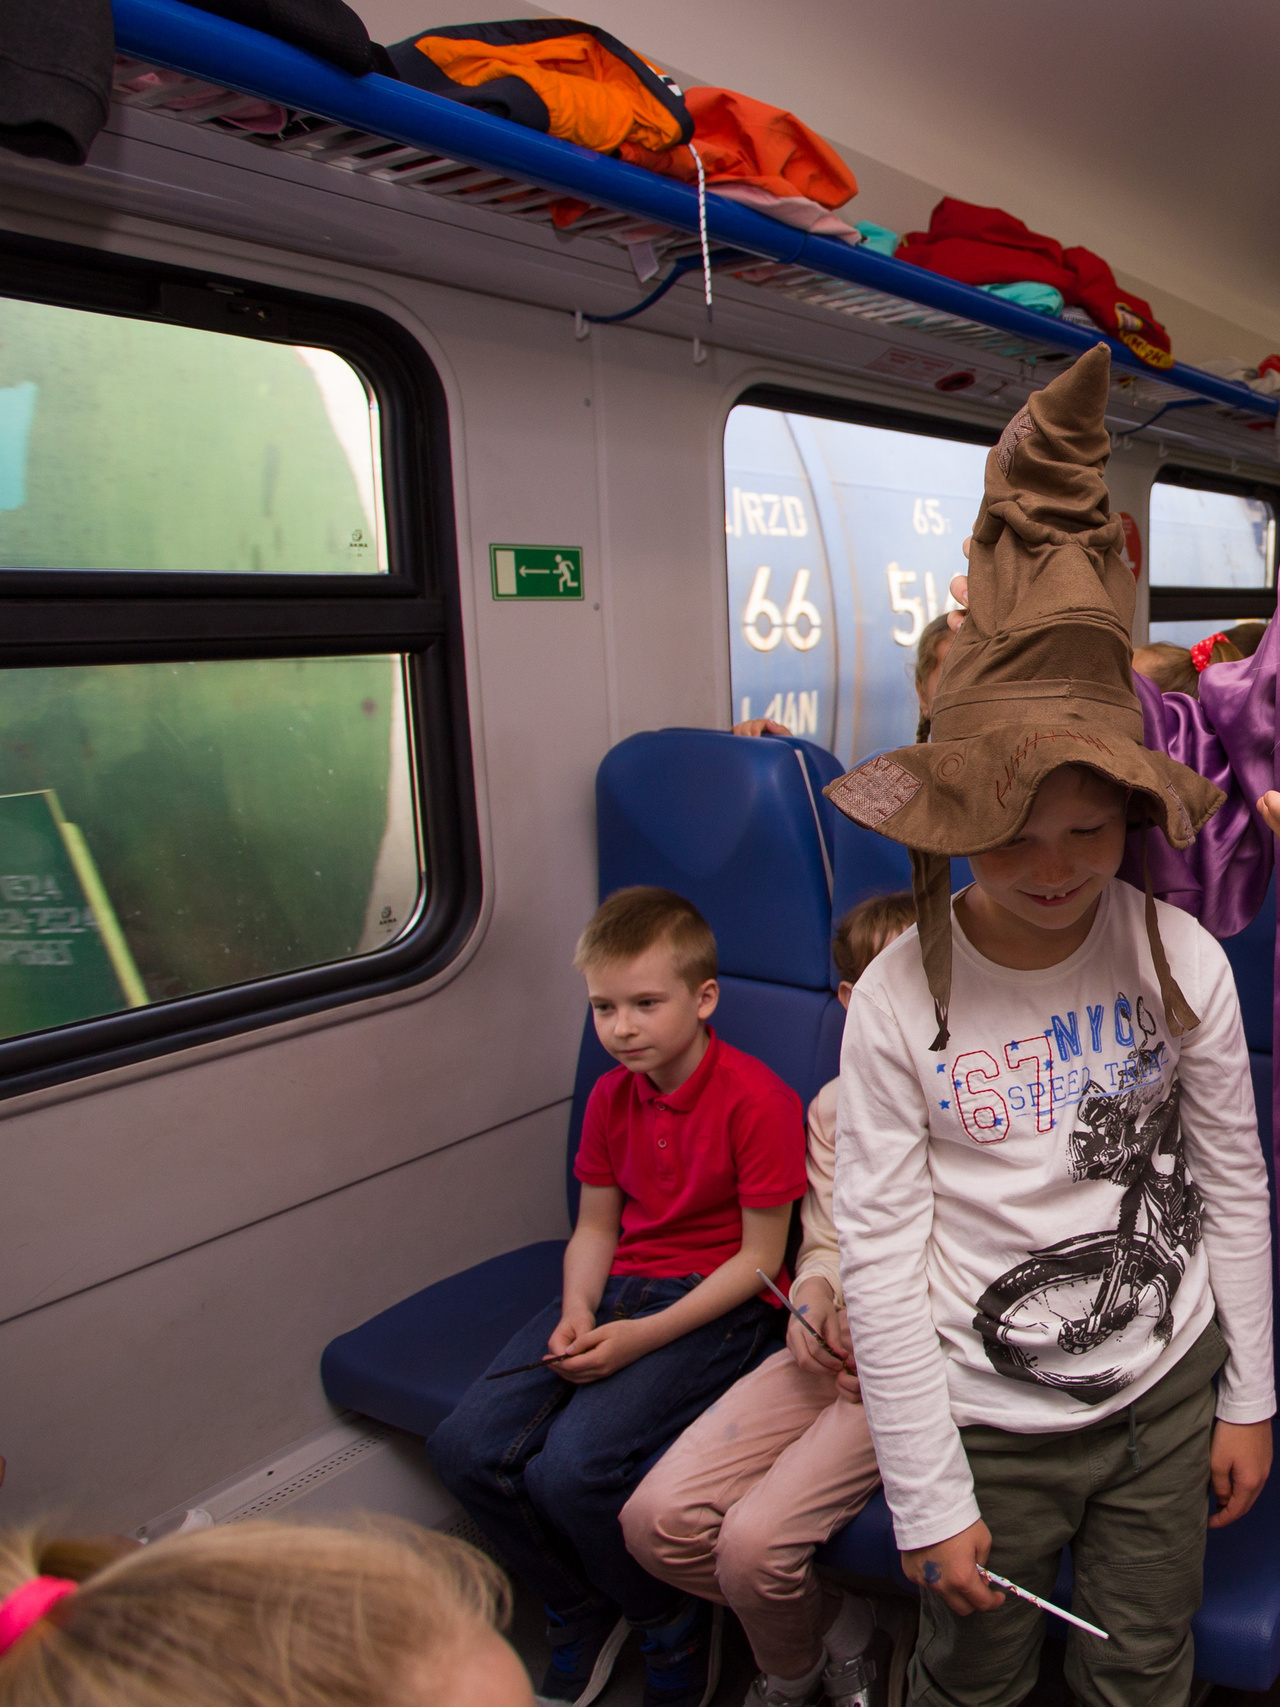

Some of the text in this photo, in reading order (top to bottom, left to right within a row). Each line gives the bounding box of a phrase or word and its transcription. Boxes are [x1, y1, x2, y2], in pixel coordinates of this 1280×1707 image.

[743, 566, 822, 652] 66
[1051, 998, 1137, 1062] NYC
[952, 1035, 1054, 1144] 67
[1008, 1047, 1169, 1111] SPEED TRIAL
